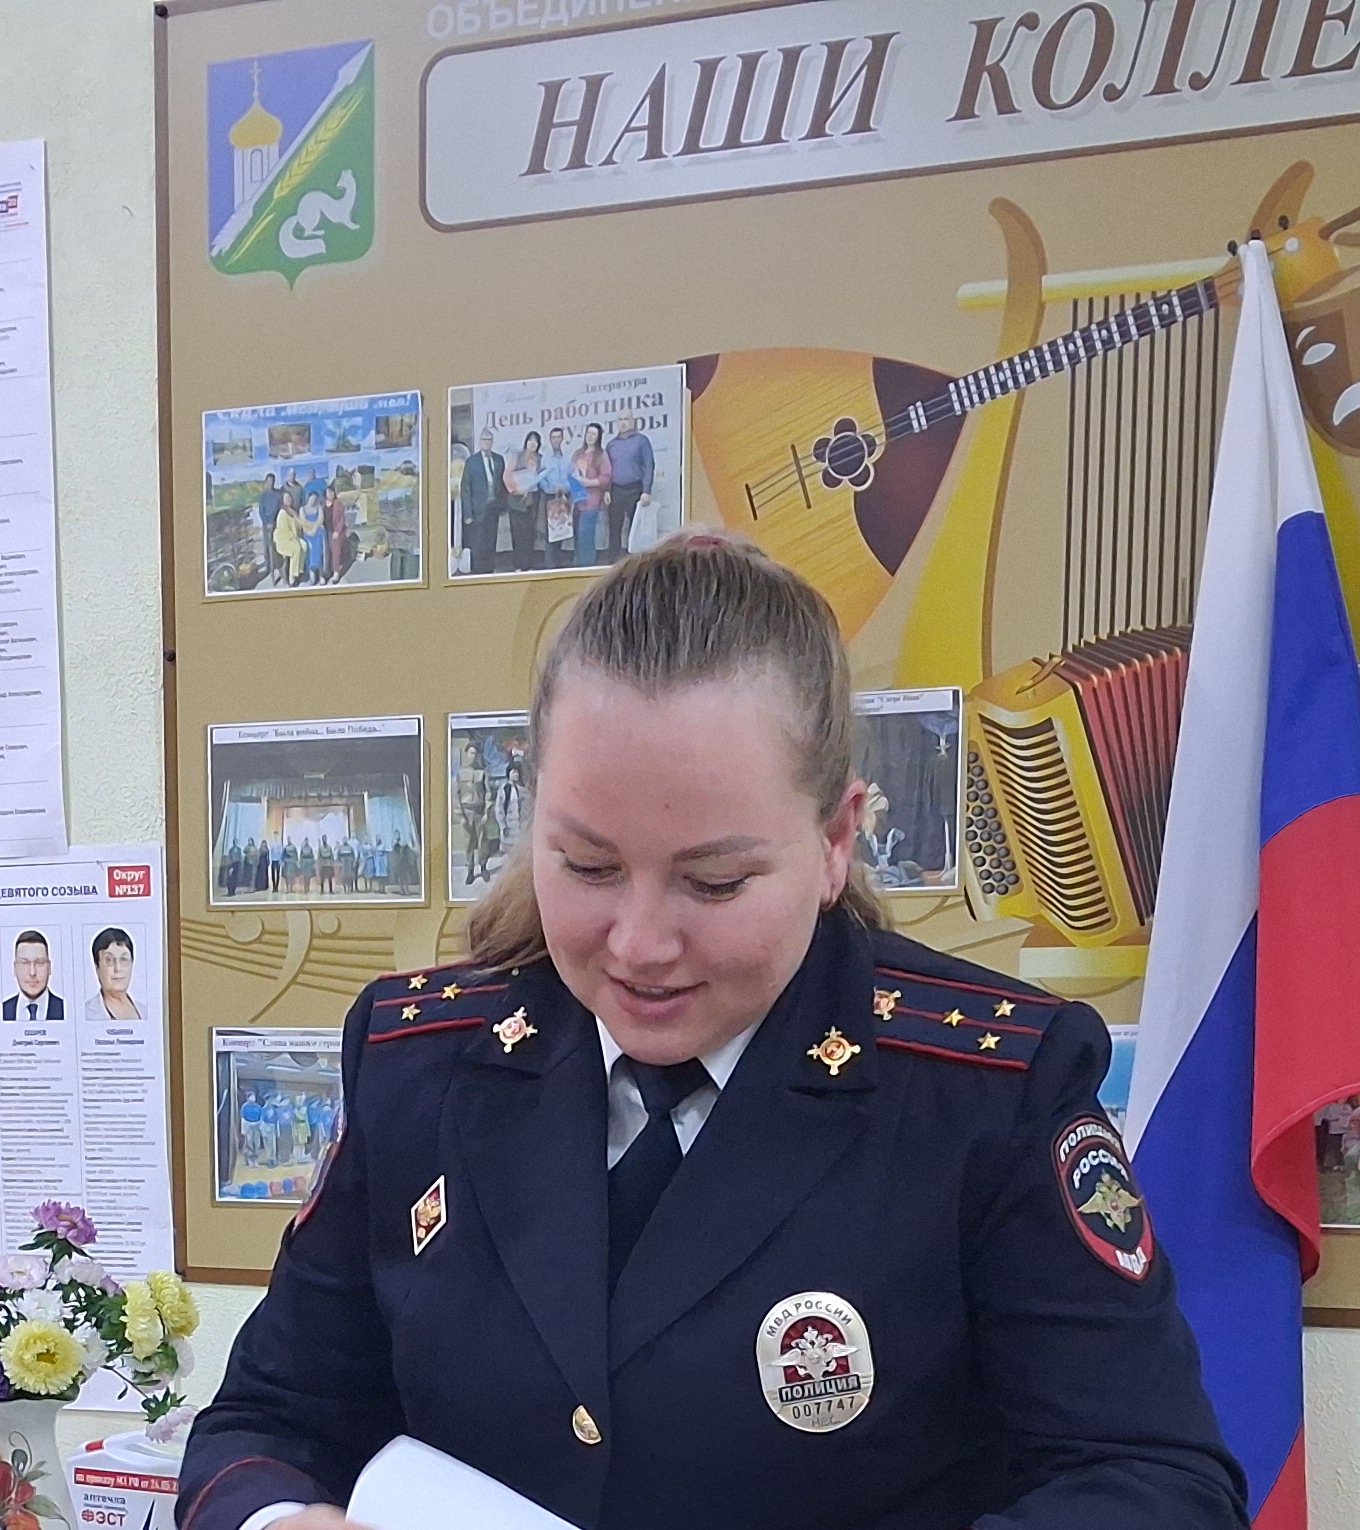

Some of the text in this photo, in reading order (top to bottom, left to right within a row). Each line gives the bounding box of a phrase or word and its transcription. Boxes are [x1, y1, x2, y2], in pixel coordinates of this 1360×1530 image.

[519, 31, 901, 177] НАШИ
[583, 376, 647, 394] Литература
[486, 390, 665, 431] День работника
[113, 869, 146, 883] Округ
[51, 884, 98, 897] СОЗЫВА
[114, 883, 145, 896] №137
[766, 1300, 853, 1338] МВД РОССИИ
[781, 1375, 858, 1402] ПОЛИЦИЯ
[792, 1396, 855, 1419] 007747
[83, 1493, 126, 1505] аптечка
[81, 1509, 127, 1527] ФЭСТ
